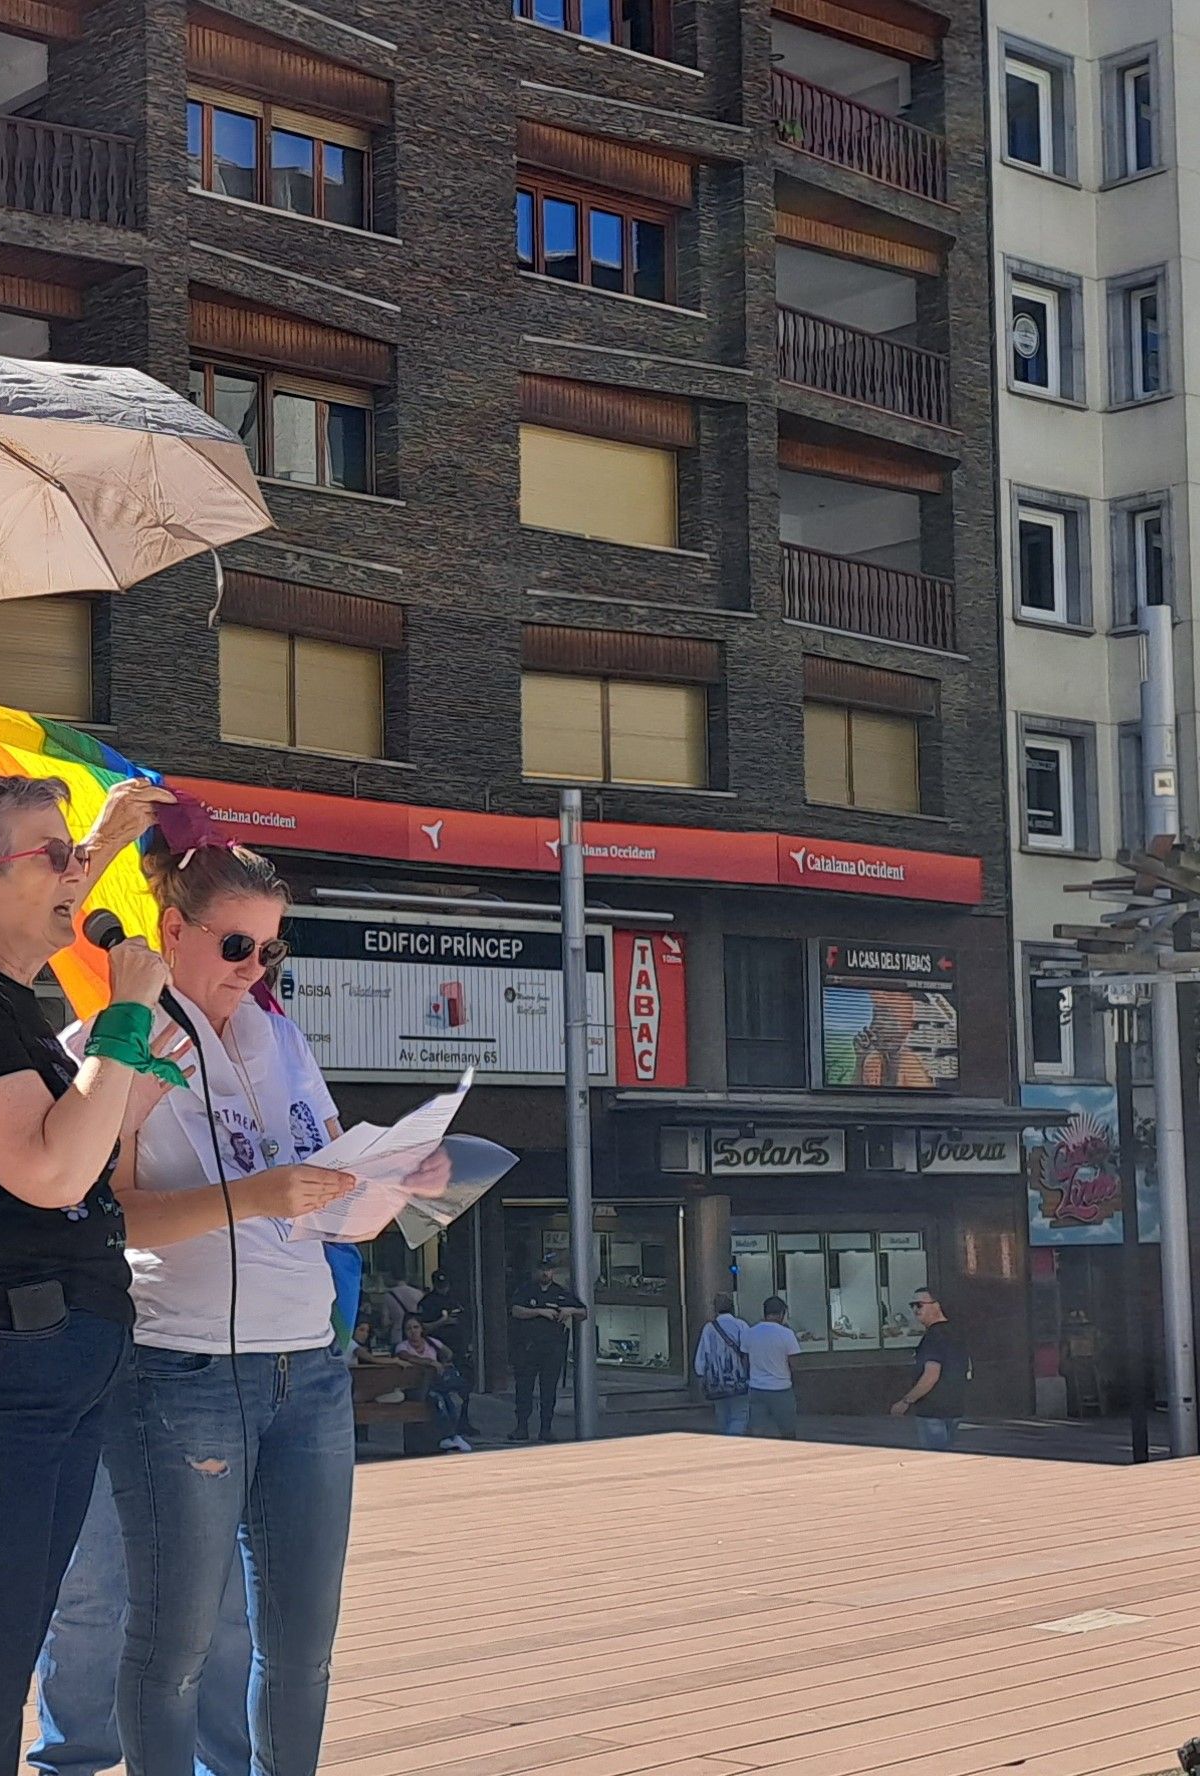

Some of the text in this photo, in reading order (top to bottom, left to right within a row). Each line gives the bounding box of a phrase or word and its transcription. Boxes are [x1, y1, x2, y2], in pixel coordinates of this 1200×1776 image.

[206, 806, 297, 829] Catalana Occident
[609, 845, 656, 860] Occident
[806, 853, 905, 881] Catalana Occident
[365, 930, 523, 960] EDIFICI PRÍNCEP
[847, 949, 932, 973] LA CASA DELS TABACS
[298, 984, 331, 998] AGISA
[634, 945, 654, 1072] TABAC
[399, 1049, 498, 1066] Av. Carlemany 65
